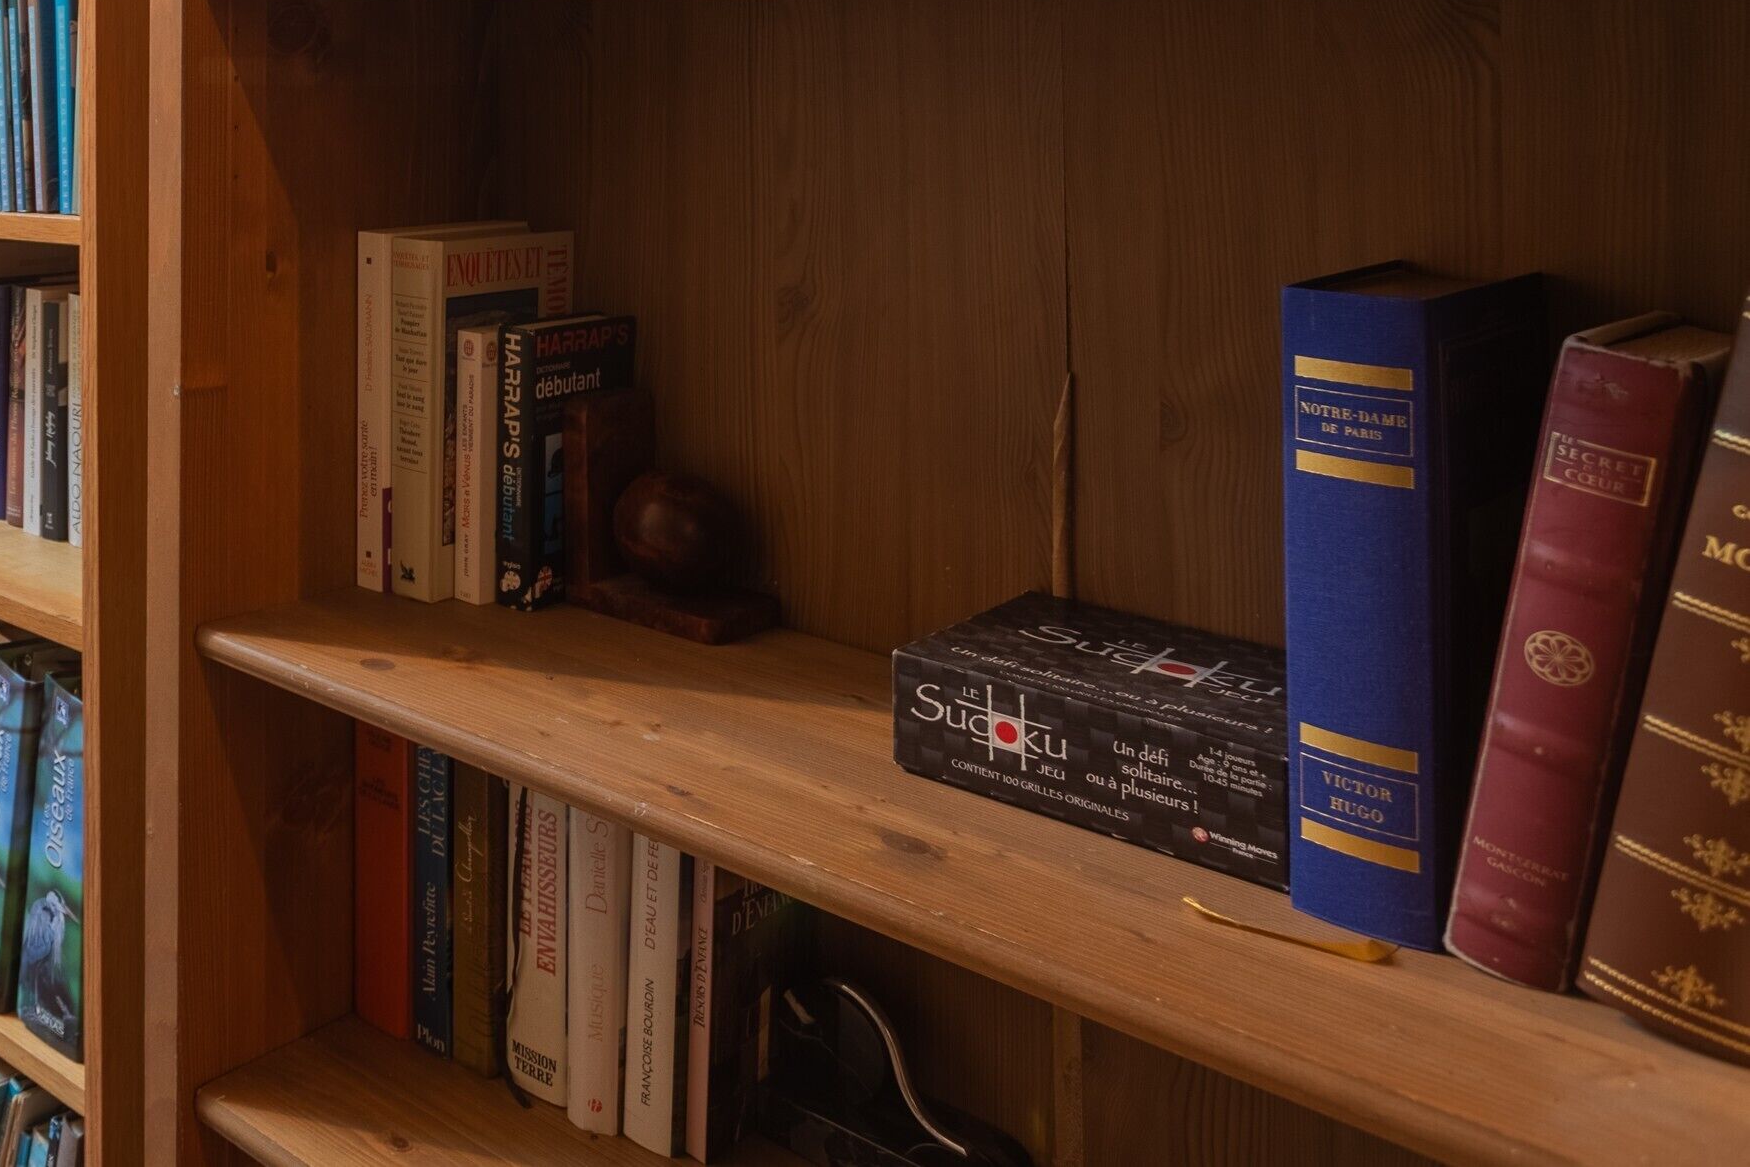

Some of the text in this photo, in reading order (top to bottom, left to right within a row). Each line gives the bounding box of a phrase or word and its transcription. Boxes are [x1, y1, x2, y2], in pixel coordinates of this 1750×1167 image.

[446, 247, 523, 288] ENQUÊTES
[523, 245, 544, 279] ET
[535, 325, 629, 358] HARRAP'S
[503, 333, 522, 459] HARRAP'S
[535, 368, 601, 400] débutant
[1299, 400, 1409, 429] NOTRE-DAME
[1321, 422, 1383, 442] DE PARIS
[71, 403, 82, 534] ALDO NAOURI
[359, 420, 370, 519] Prenez santé
[1556, 444, 1644, 476] SECRET
[502, 464, 515, 541] débutant
[962, 686, 980, 700] LE
[0, 732, 12, 793] de France
[1112, 740, 1169, 767] Un défi
[1224, 751, 1257, 767] joueurs
[64, 758, 75, 821] de France
[951, 758, 1130, 822] CONTIENT 100 GRILLES ORIGINALES
[1036, 764, 1066, 781] JEU
[1121, 762, 1199, 796] solitaire...
[1230, 782, 1264, 798] minutes
[1240, 776, 1267, 790] partie
[1320, 770, 1394, 803] VICTOR
[44, 749, 68, 869] Oiseaux
[1085, 772, 1190, 813] ou à plusieurs
[1329, 795, 1385, 824] HUGO
[42, 803, 51, 827] Les
[417, 800, 432, 836] LES
[430, 778, 445, 859] DU LAC
[1208, 830, 1279, 860] Winning Moves
[1472, 834, 1572, 883] MONTSERRAT
[1486, 854, 1547, 889] GASCON
[536, 809, 557, 977] ENVAHISSEURS
[422, 881, 438, 1002] Alain Peyrefitte
[585, 843, 608, 1042] Musique Danielle
[640, 860, 659, 1107] FRANÇOISE BOURDIN D'EAU ET DE
[511, 1039, 558, 1075] MISSION
[514, 1056, 554, 1087] TERRE
